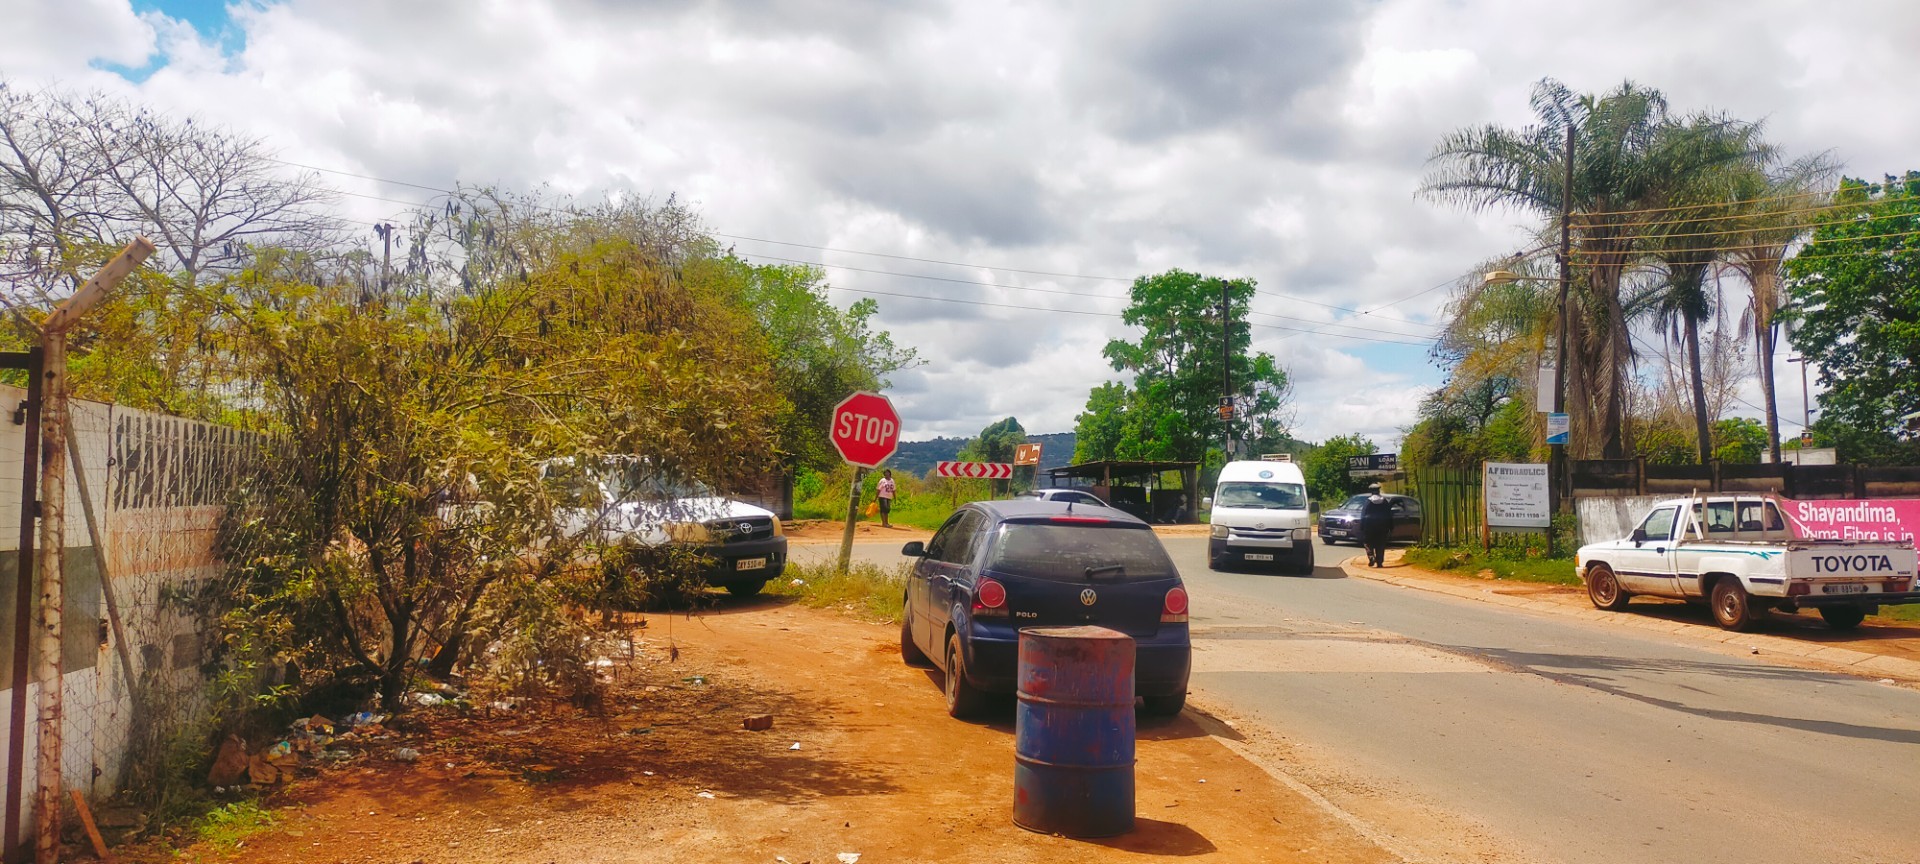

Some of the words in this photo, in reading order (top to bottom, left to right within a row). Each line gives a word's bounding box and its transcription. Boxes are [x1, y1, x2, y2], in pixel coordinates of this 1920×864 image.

[838, 411, 895, 447] STOP
[1500, 467, 1546, 477] HYDRAULICS
[1798, 502, 1901, 526] Shayandima,
[1843, 525, 1880, 540] Fibre
[1883, 527, 1896, 541] is
[1811, 555, 1893, 573] TOYOTA
